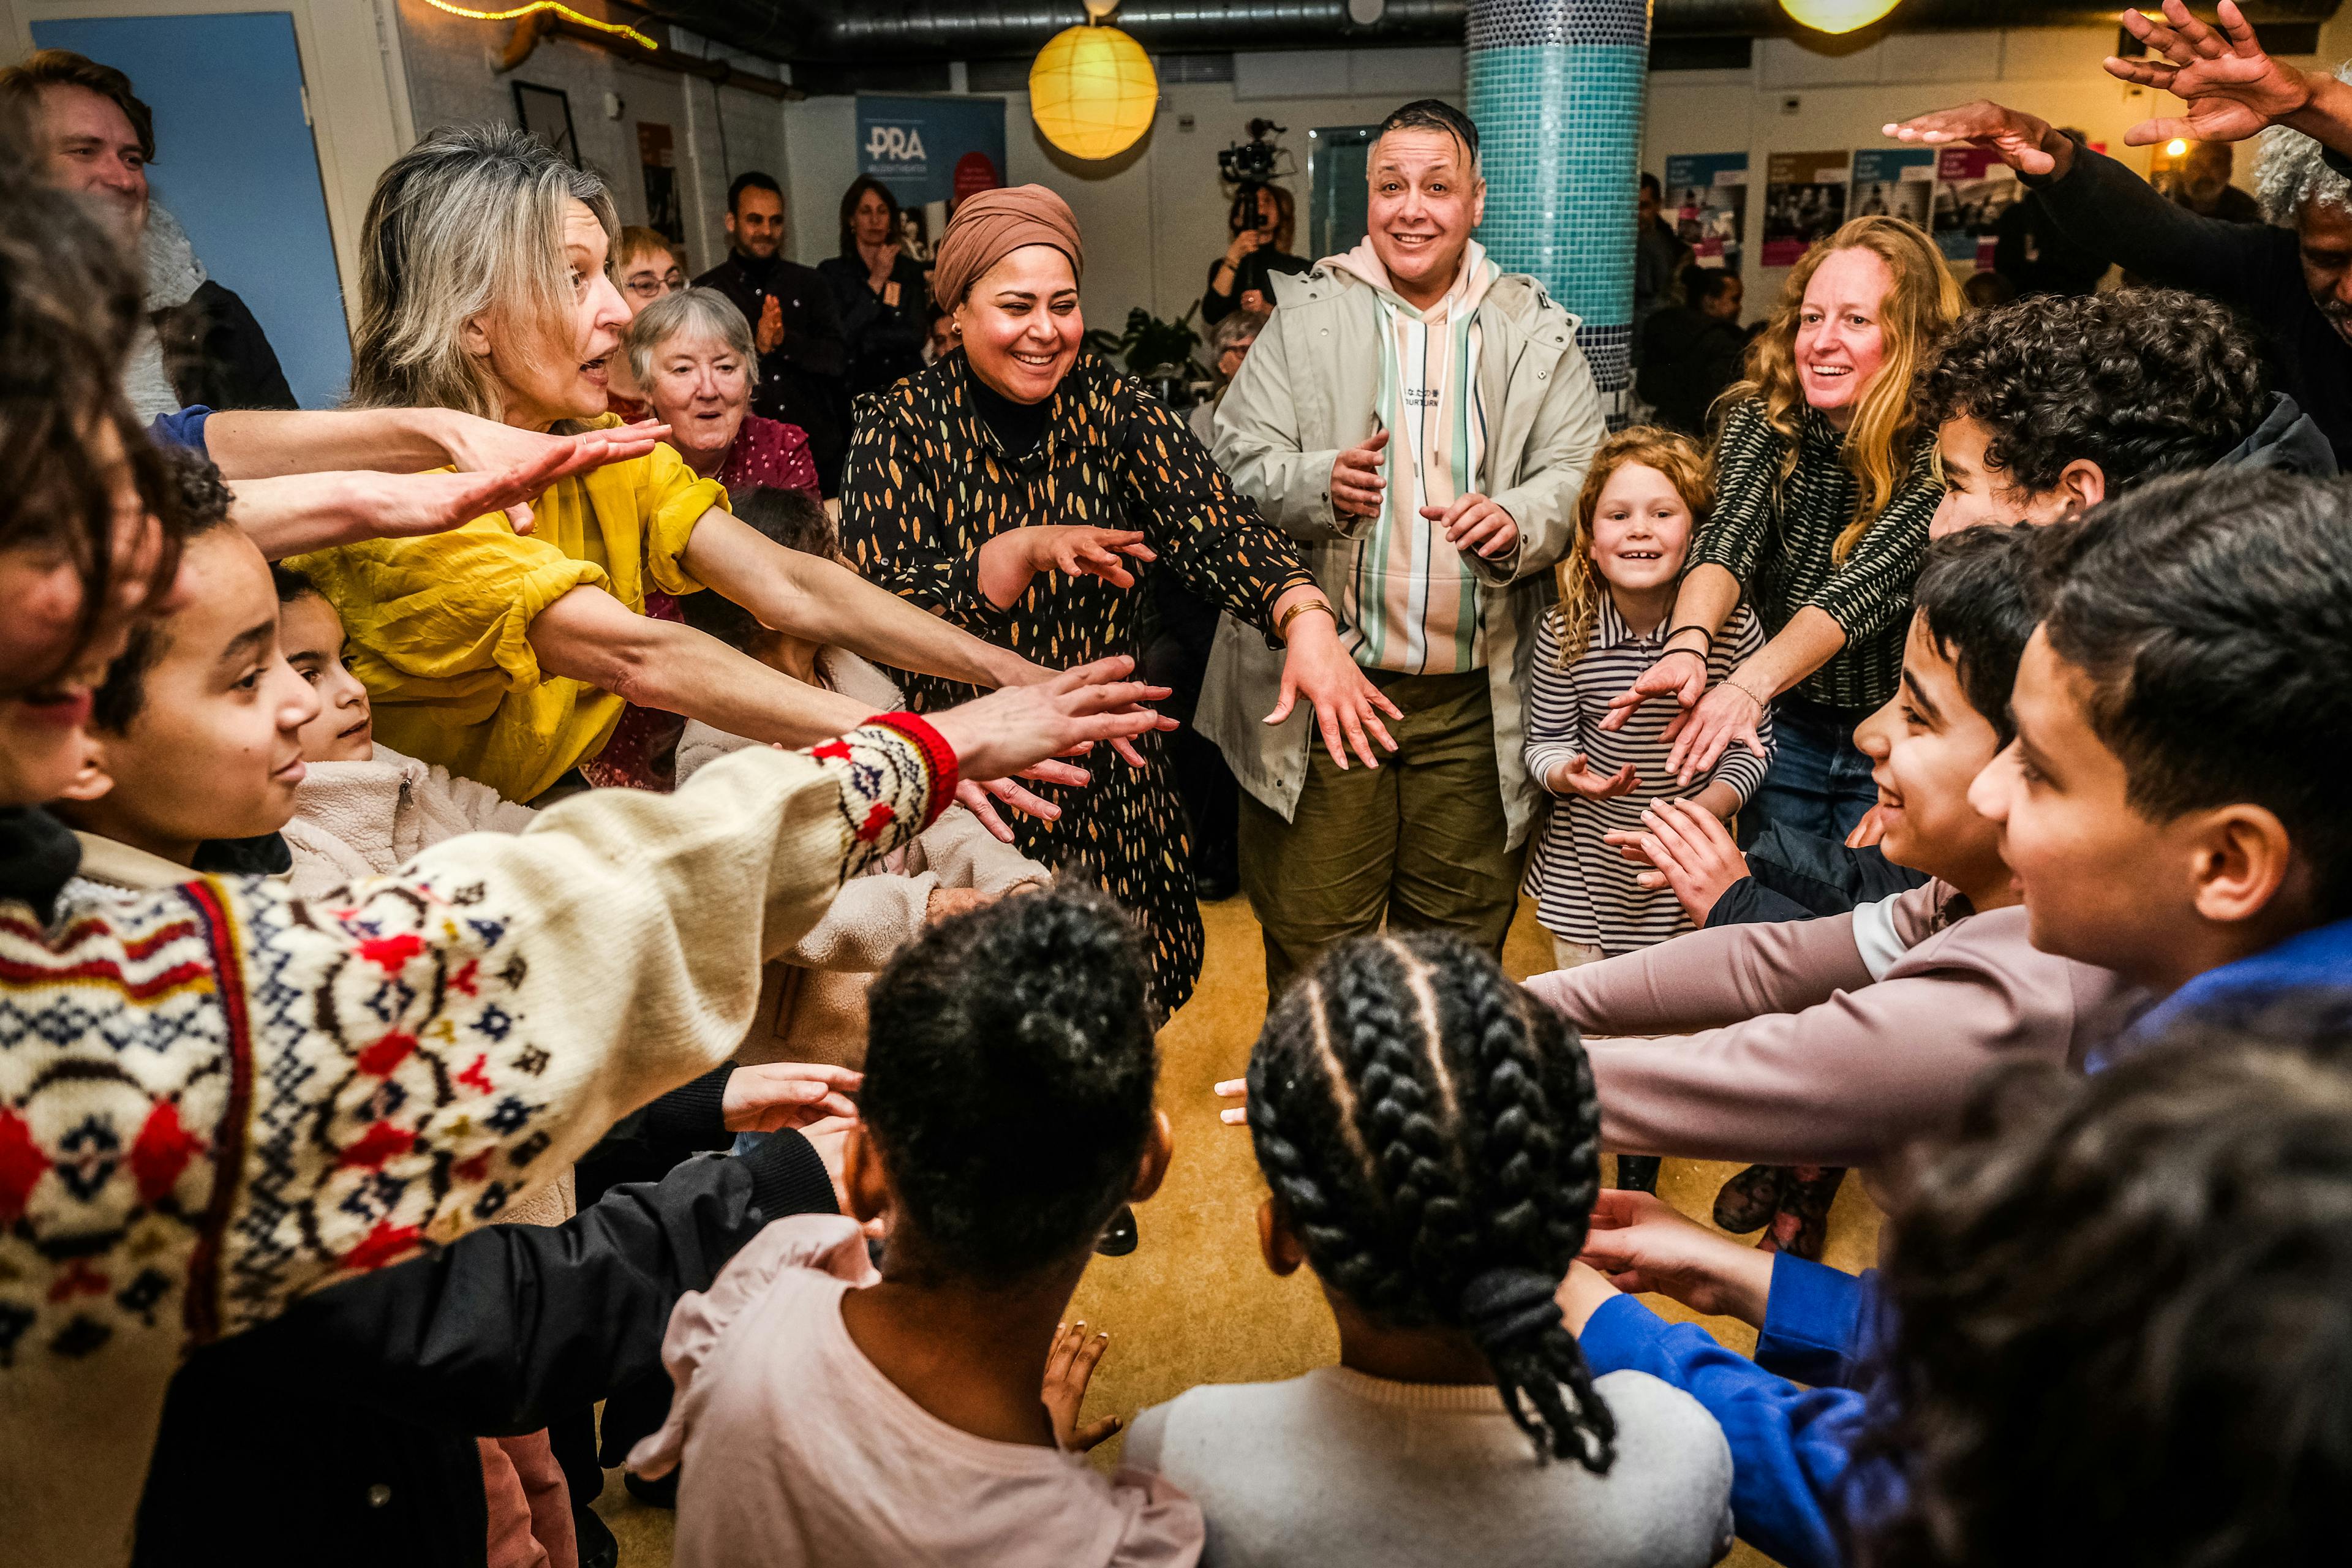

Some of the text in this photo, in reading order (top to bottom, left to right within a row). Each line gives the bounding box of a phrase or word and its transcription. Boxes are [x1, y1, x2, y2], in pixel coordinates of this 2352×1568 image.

[865, 127, 926, 160] PRA
[1405, 388, 1438, 398] なたの番
